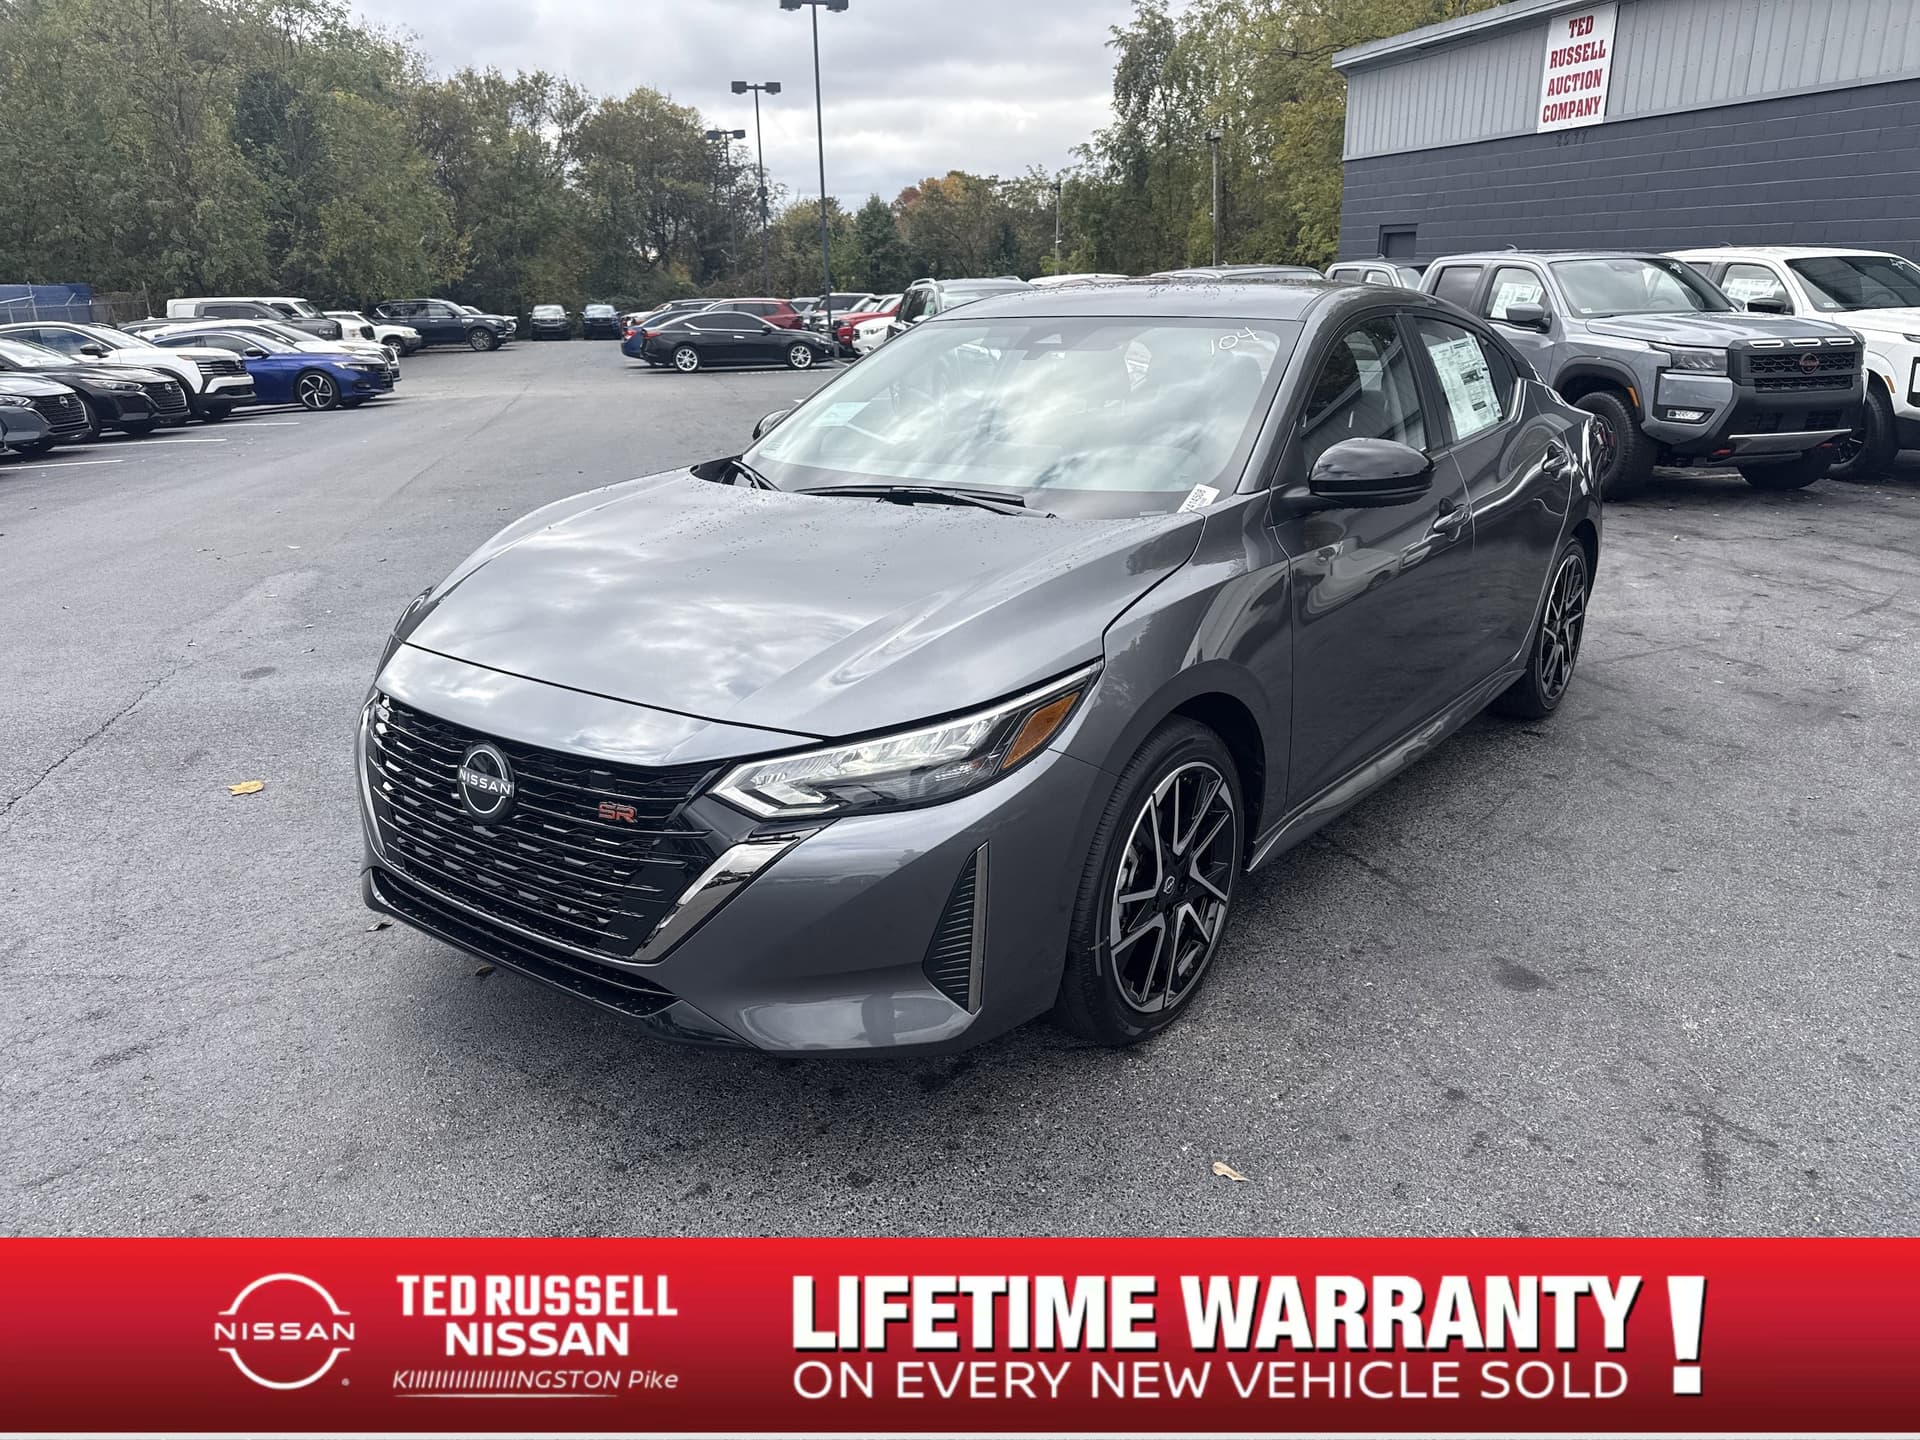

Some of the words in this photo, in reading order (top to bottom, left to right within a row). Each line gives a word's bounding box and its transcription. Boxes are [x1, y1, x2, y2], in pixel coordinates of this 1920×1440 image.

[1568, 15, 1594, 39] TED
[1549, 40, 1607, 69] RUSSELL
[1547, 69, 1603, 97] AUCTION
[1542, 96, 1602, 123] COMPANY
[1210, 326, 1260, 355] 104
[459, 768, 511, 795] NISSAN
[598, 802, 637, 823] SR
